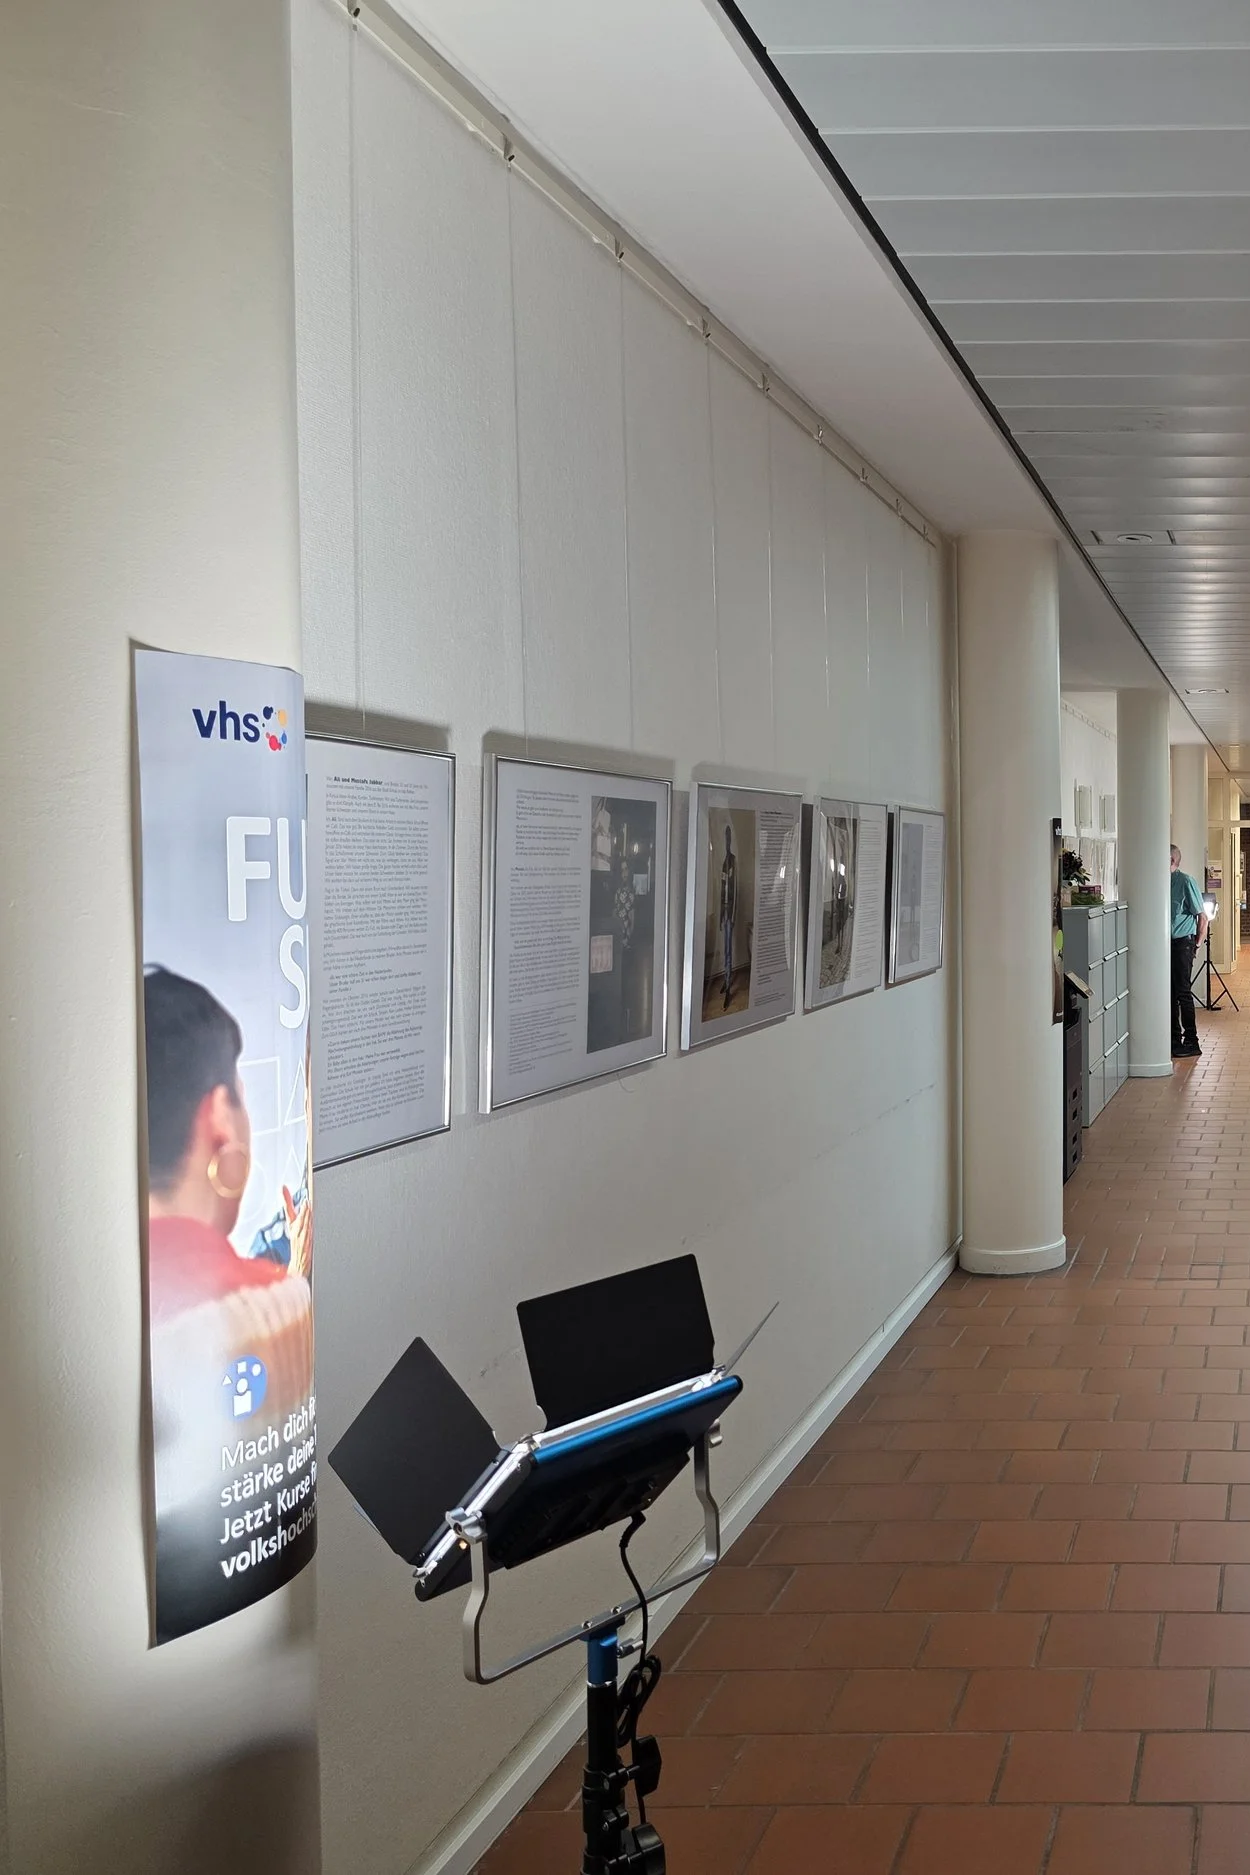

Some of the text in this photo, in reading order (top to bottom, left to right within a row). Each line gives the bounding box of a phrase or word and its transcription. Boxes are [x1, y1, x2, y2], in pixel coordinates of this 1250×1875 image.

[191, 700, 260, 743] vhs
[279, 924, 309, 1030] S
[220, 1435, 314, 1507] stärke deine
[221, 1426, 279, 1471] Mach
[283, 1406, 308, 1443] dich
[220, 1500, 272, 1545] Jetzt
[277, 1474, 310, 1516] Kurse
